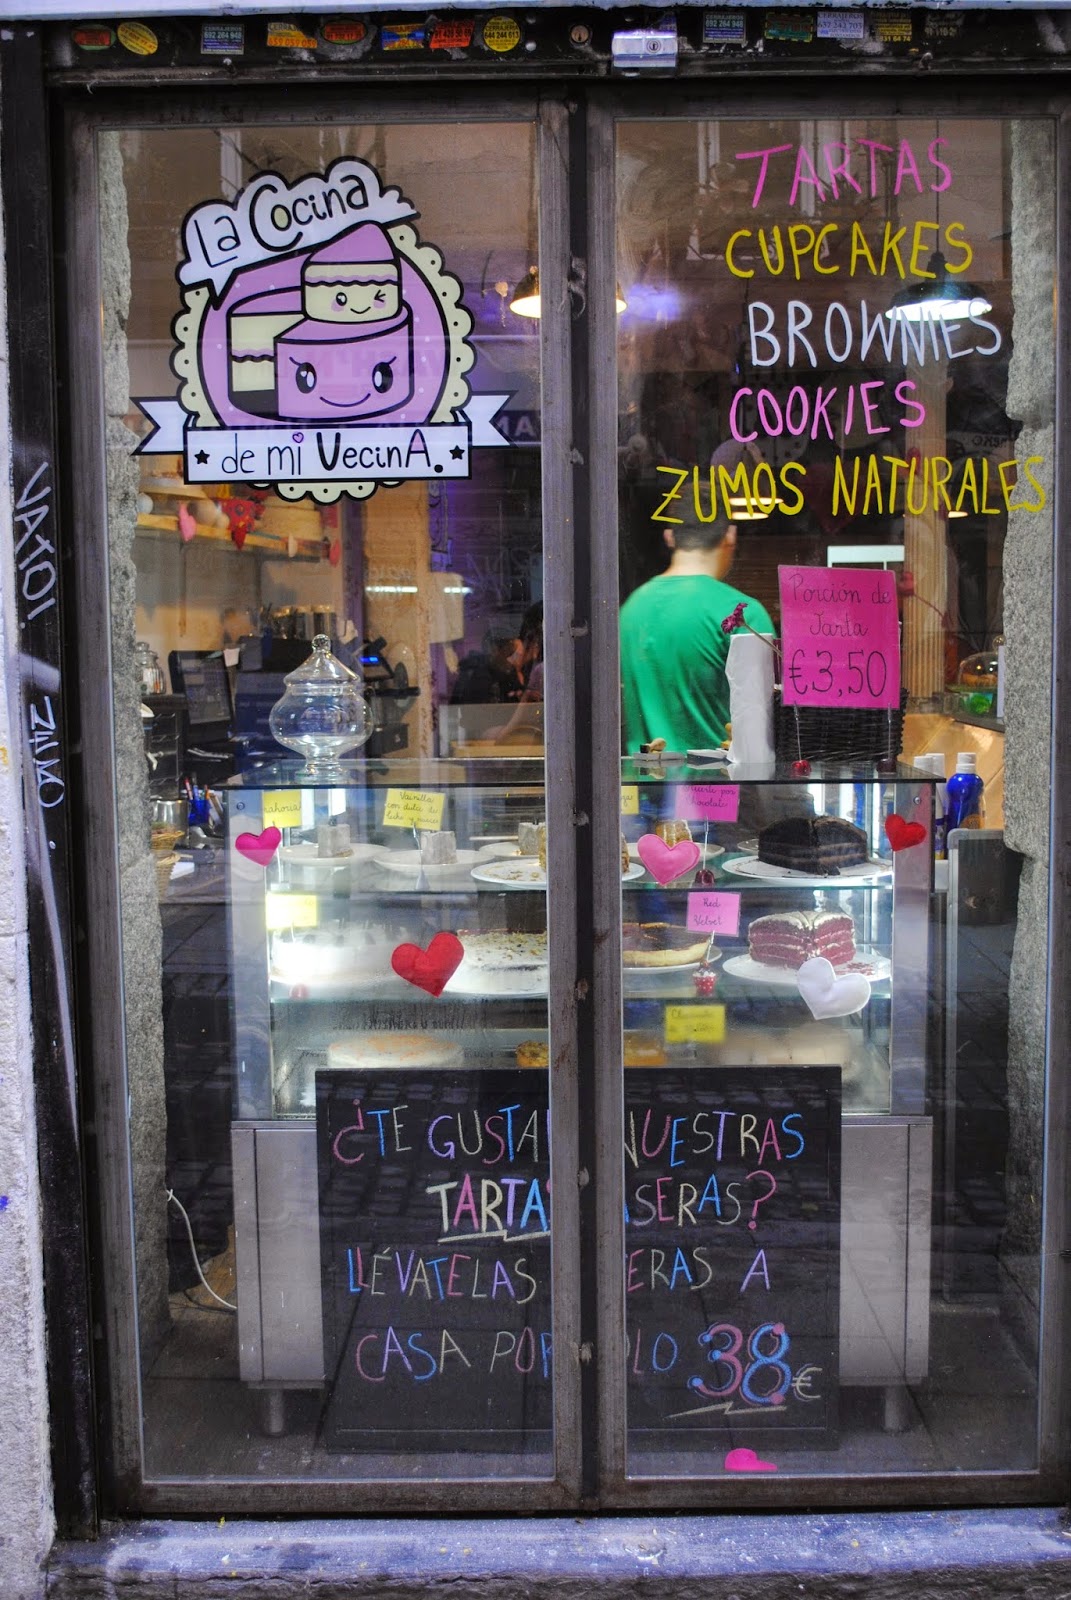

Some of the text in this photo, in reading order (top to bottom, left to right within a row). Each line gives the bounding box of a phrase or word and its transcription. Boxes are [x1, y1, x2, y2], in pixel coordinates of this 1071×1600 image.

[735, 137, 953, 208] TARTAS
[194, 173, 369, 268] La Cocina
[725, 220, 973, 280] CUPCAKES
[748, 297, 1002, 368] BROWNIES
[729, 380, 926, 443] COOKIES
[221, 432, 256, 475] de
[267, 431, 304, 475] mi
[650, 454, 1047, 524] ZUMOS NATURALES
[789, 573, 892, 604] Porción de
[788, 648, 888, 699] €3,50
[694, 914, 722, 926] Velvet
[703, 898, 721, 908] Red
[333, 1099, 412, 1165] ¿TE
[427, 1104, 551, 1165] GUSTA
[425, 1173, 551, 1233] TARTA
[347, 1247, 537, 1304] LLÉVATELAS
[740, 1249, 771, 1293] A
[356, 1325, 471, 1382] CASA
